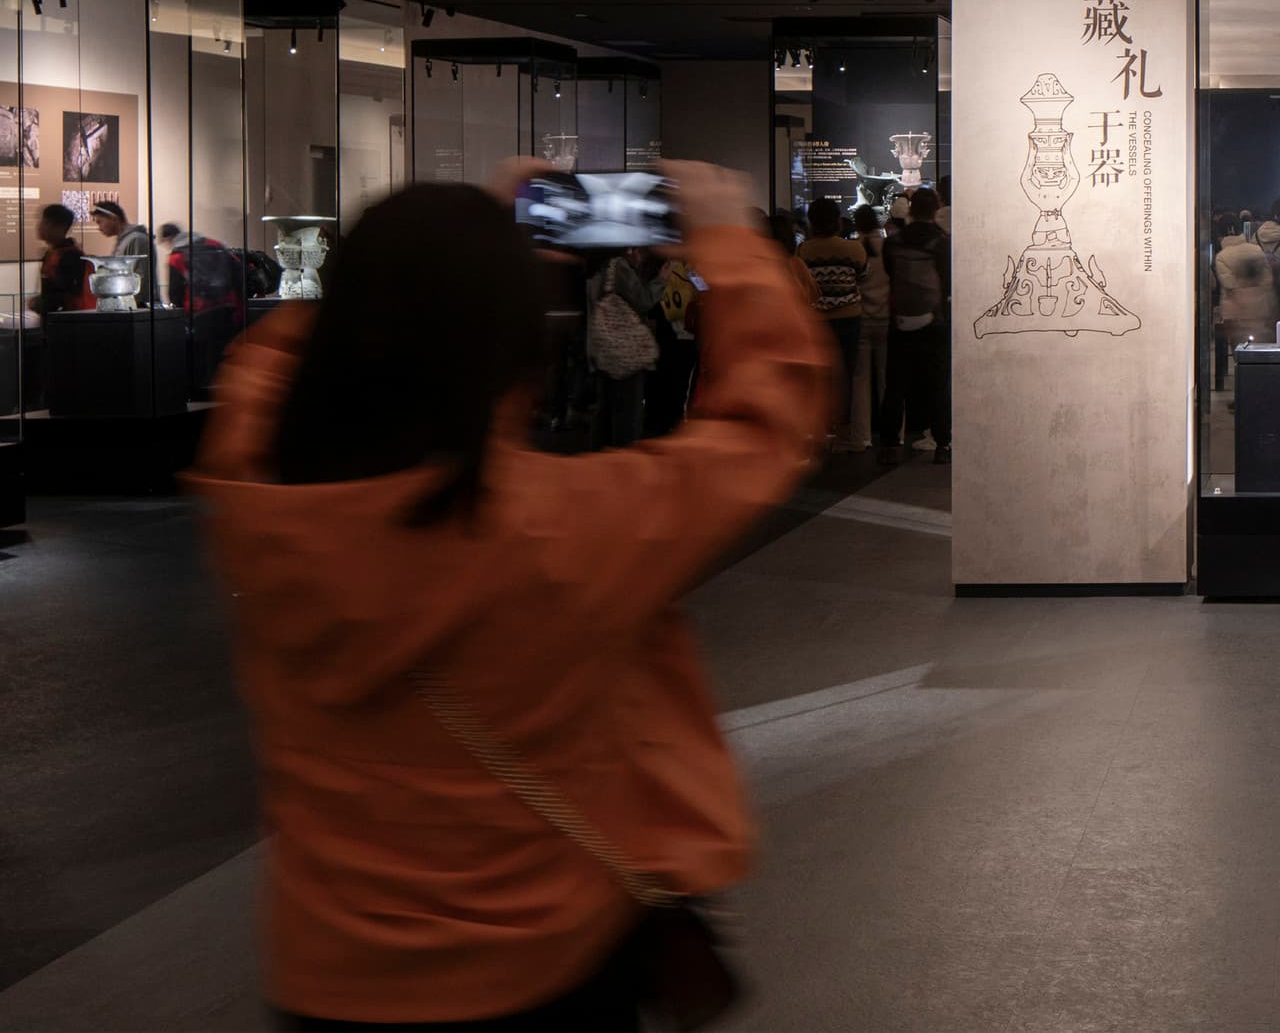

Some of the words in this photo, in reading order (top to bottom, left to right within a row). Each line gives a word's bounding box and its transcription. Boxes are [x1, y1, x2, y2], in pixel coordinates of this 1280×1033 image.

[1128, 110, 1137, 130] THE
[1128, 132, 1137, 176] VESSELS
[1143, 110, 1152, 176] CONCEALING
[1143, 177, 1152, 235] OFFERINGS
[1143, 236, 1152, 272] WITHIN
